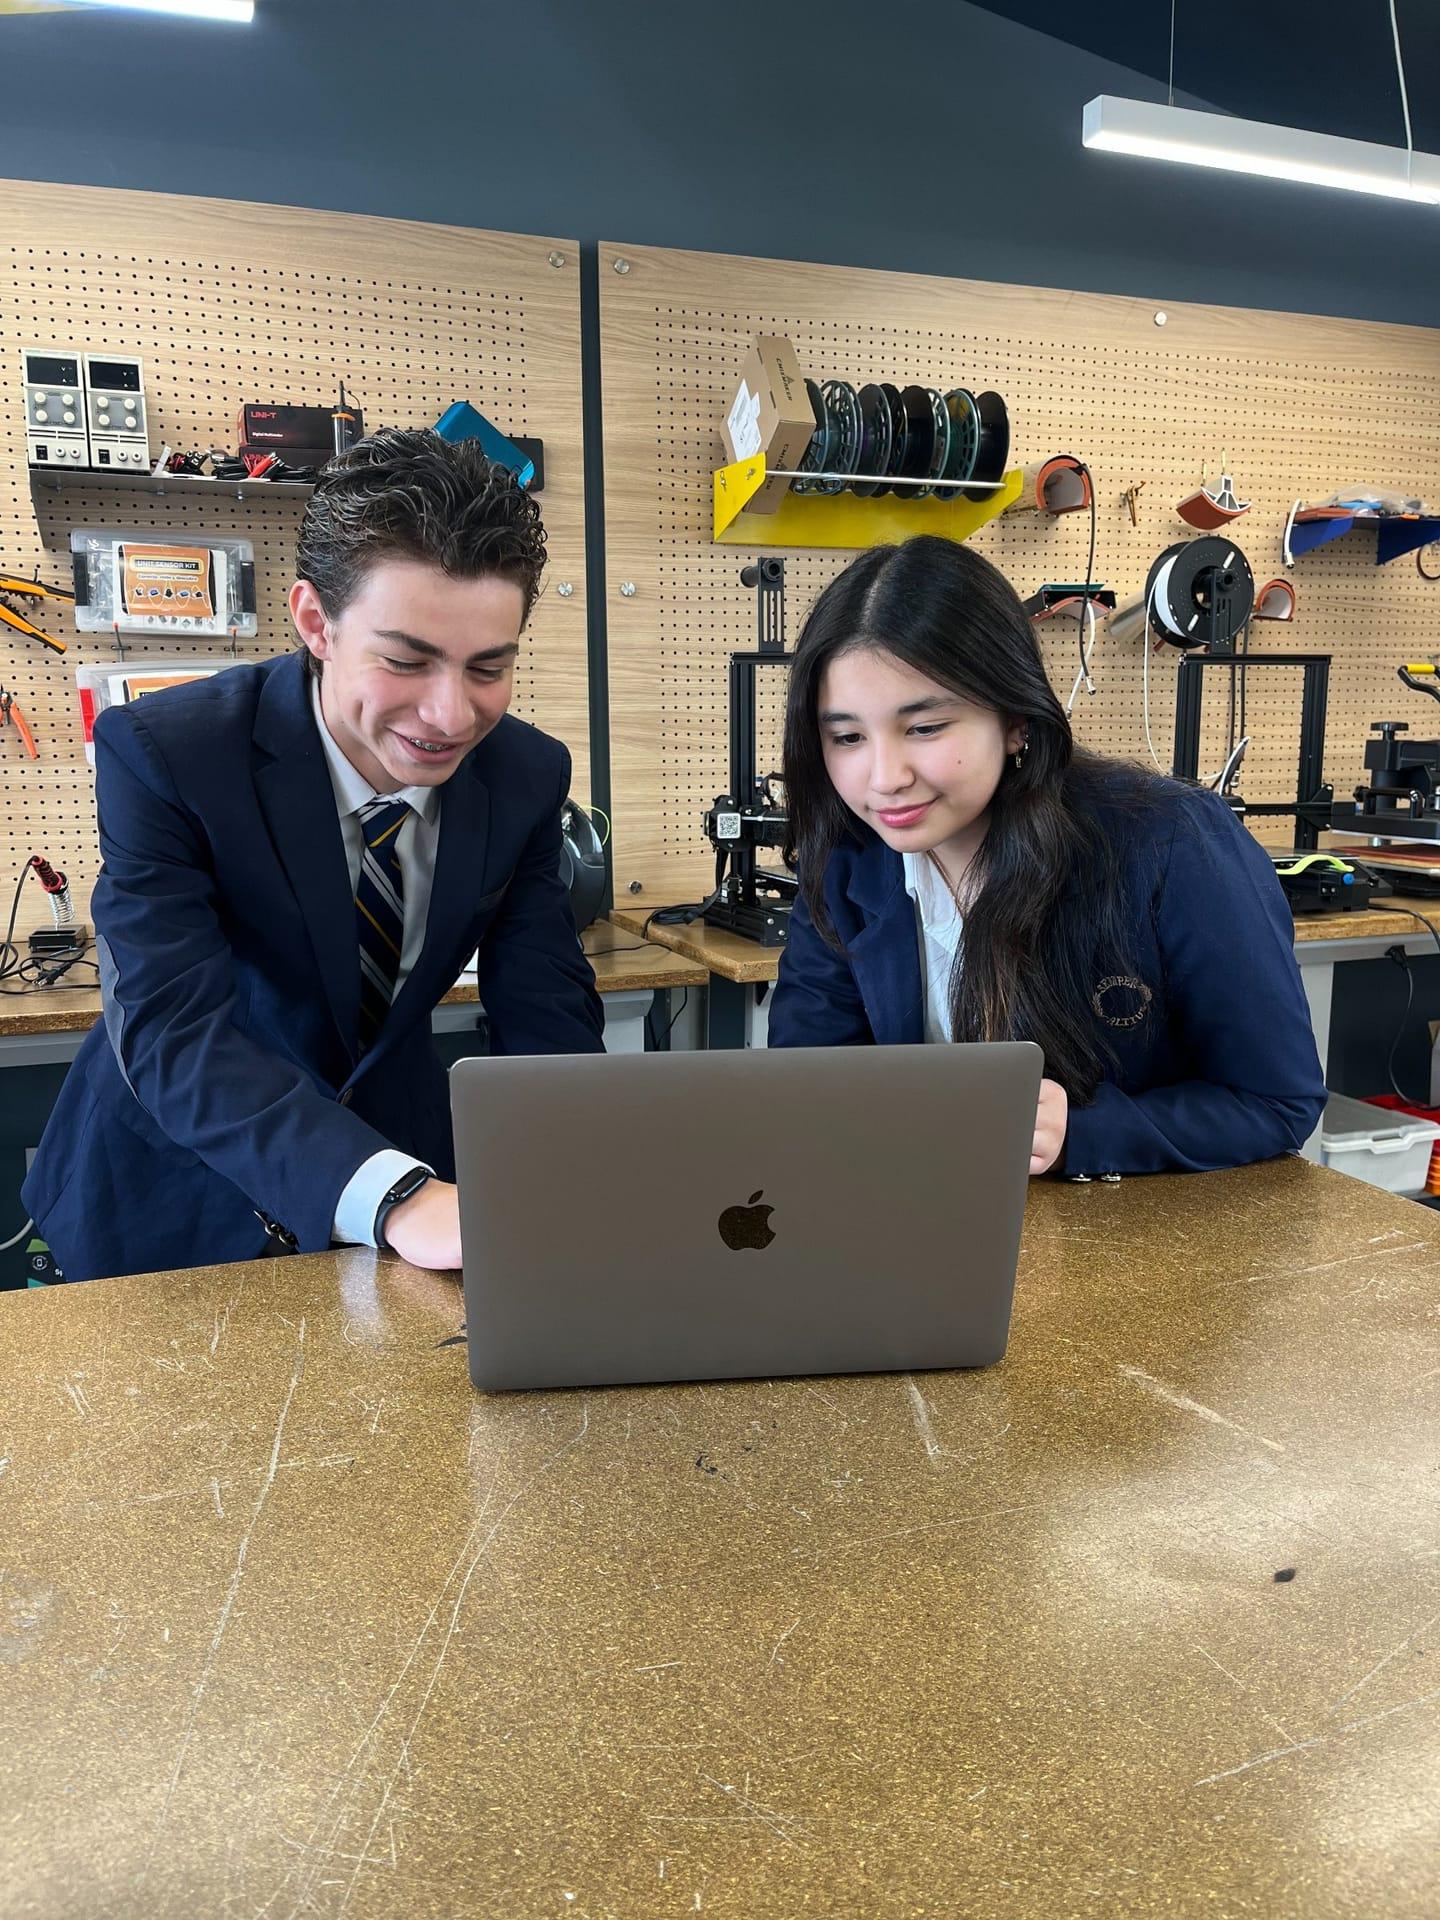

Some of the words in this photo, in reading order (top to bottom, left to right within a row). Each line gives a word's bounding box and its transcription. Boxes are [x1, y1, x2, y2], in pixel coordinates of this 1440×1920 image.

[250, 411, 277, 419] UNI-T
[137, 560, 153, 568] UNIT
[153, 561, 184, 569] SENSOR
[1097, 975, 1139, 992] SEMPER
